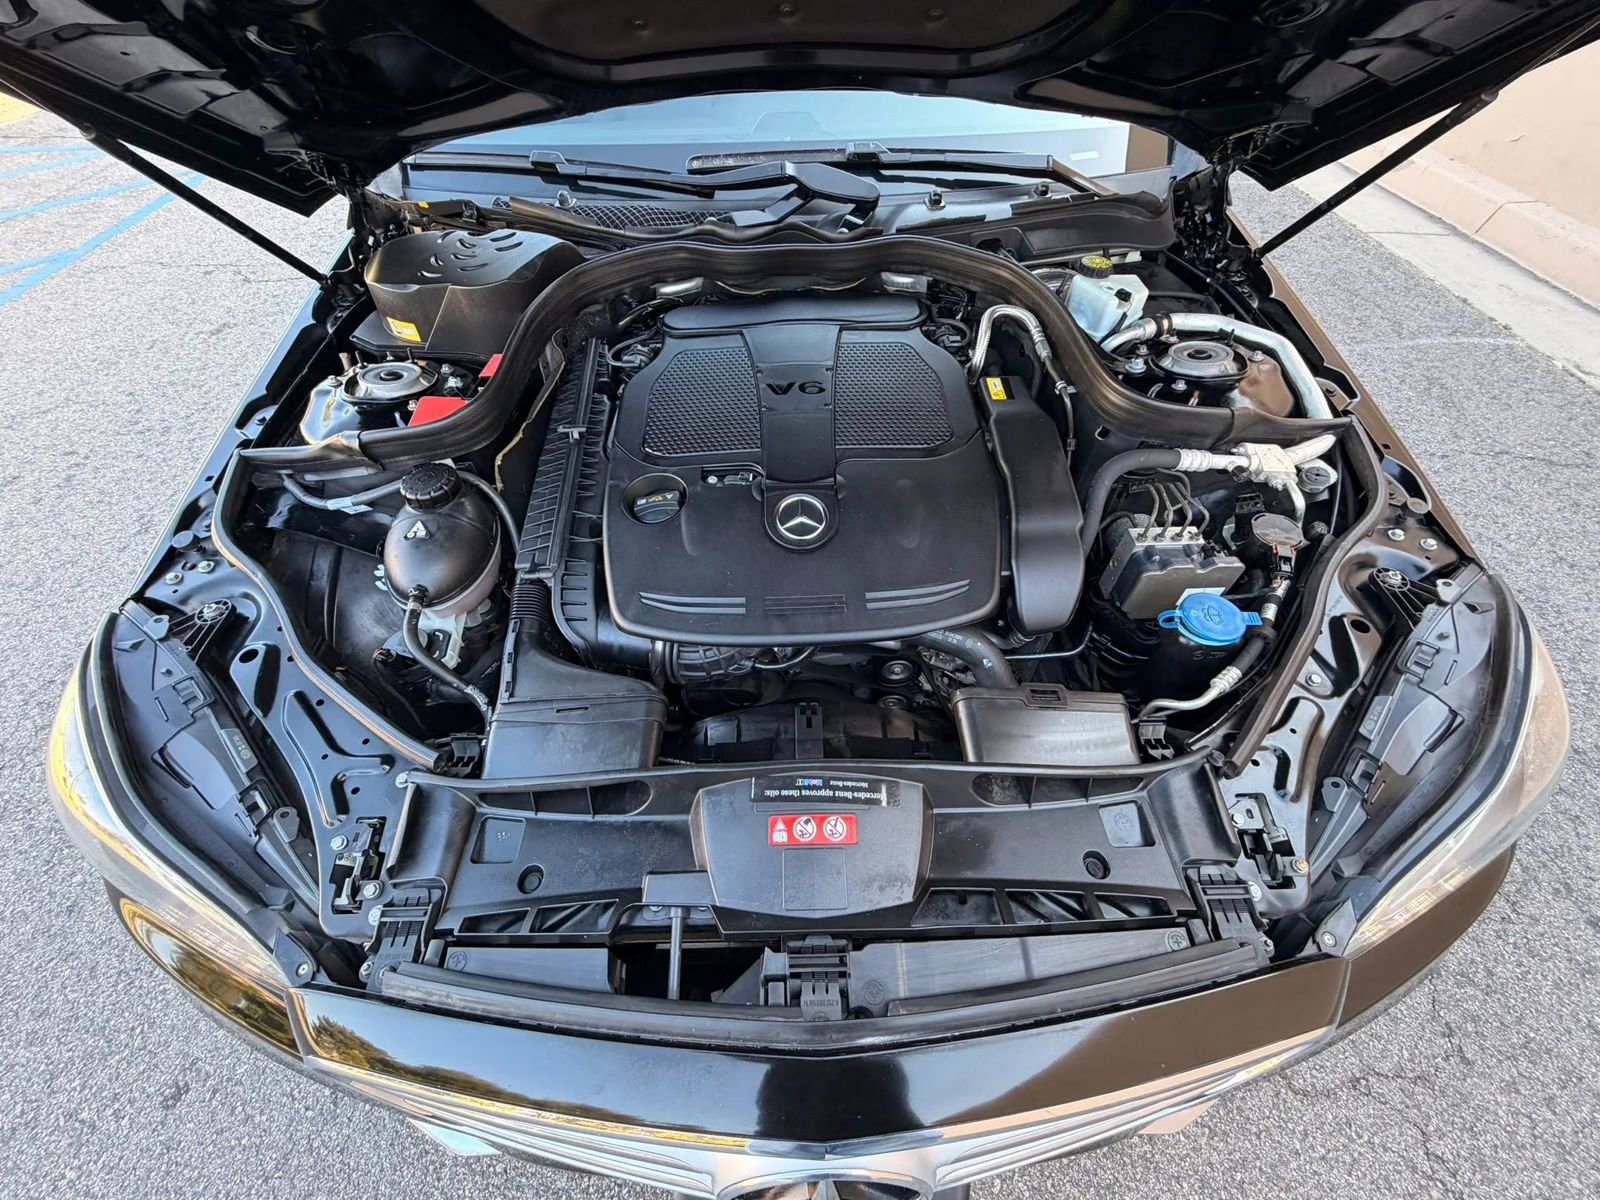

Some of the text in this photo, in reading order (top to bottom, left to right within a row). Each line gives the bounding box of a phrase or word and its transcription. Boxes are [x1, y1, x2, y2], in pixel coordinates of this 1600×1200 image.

[766, 381, 826, 395] V6
[764, 789, 780, 798] oils:
[781, 789, 800, 798] these
[801, 789, 833, 798] approves
